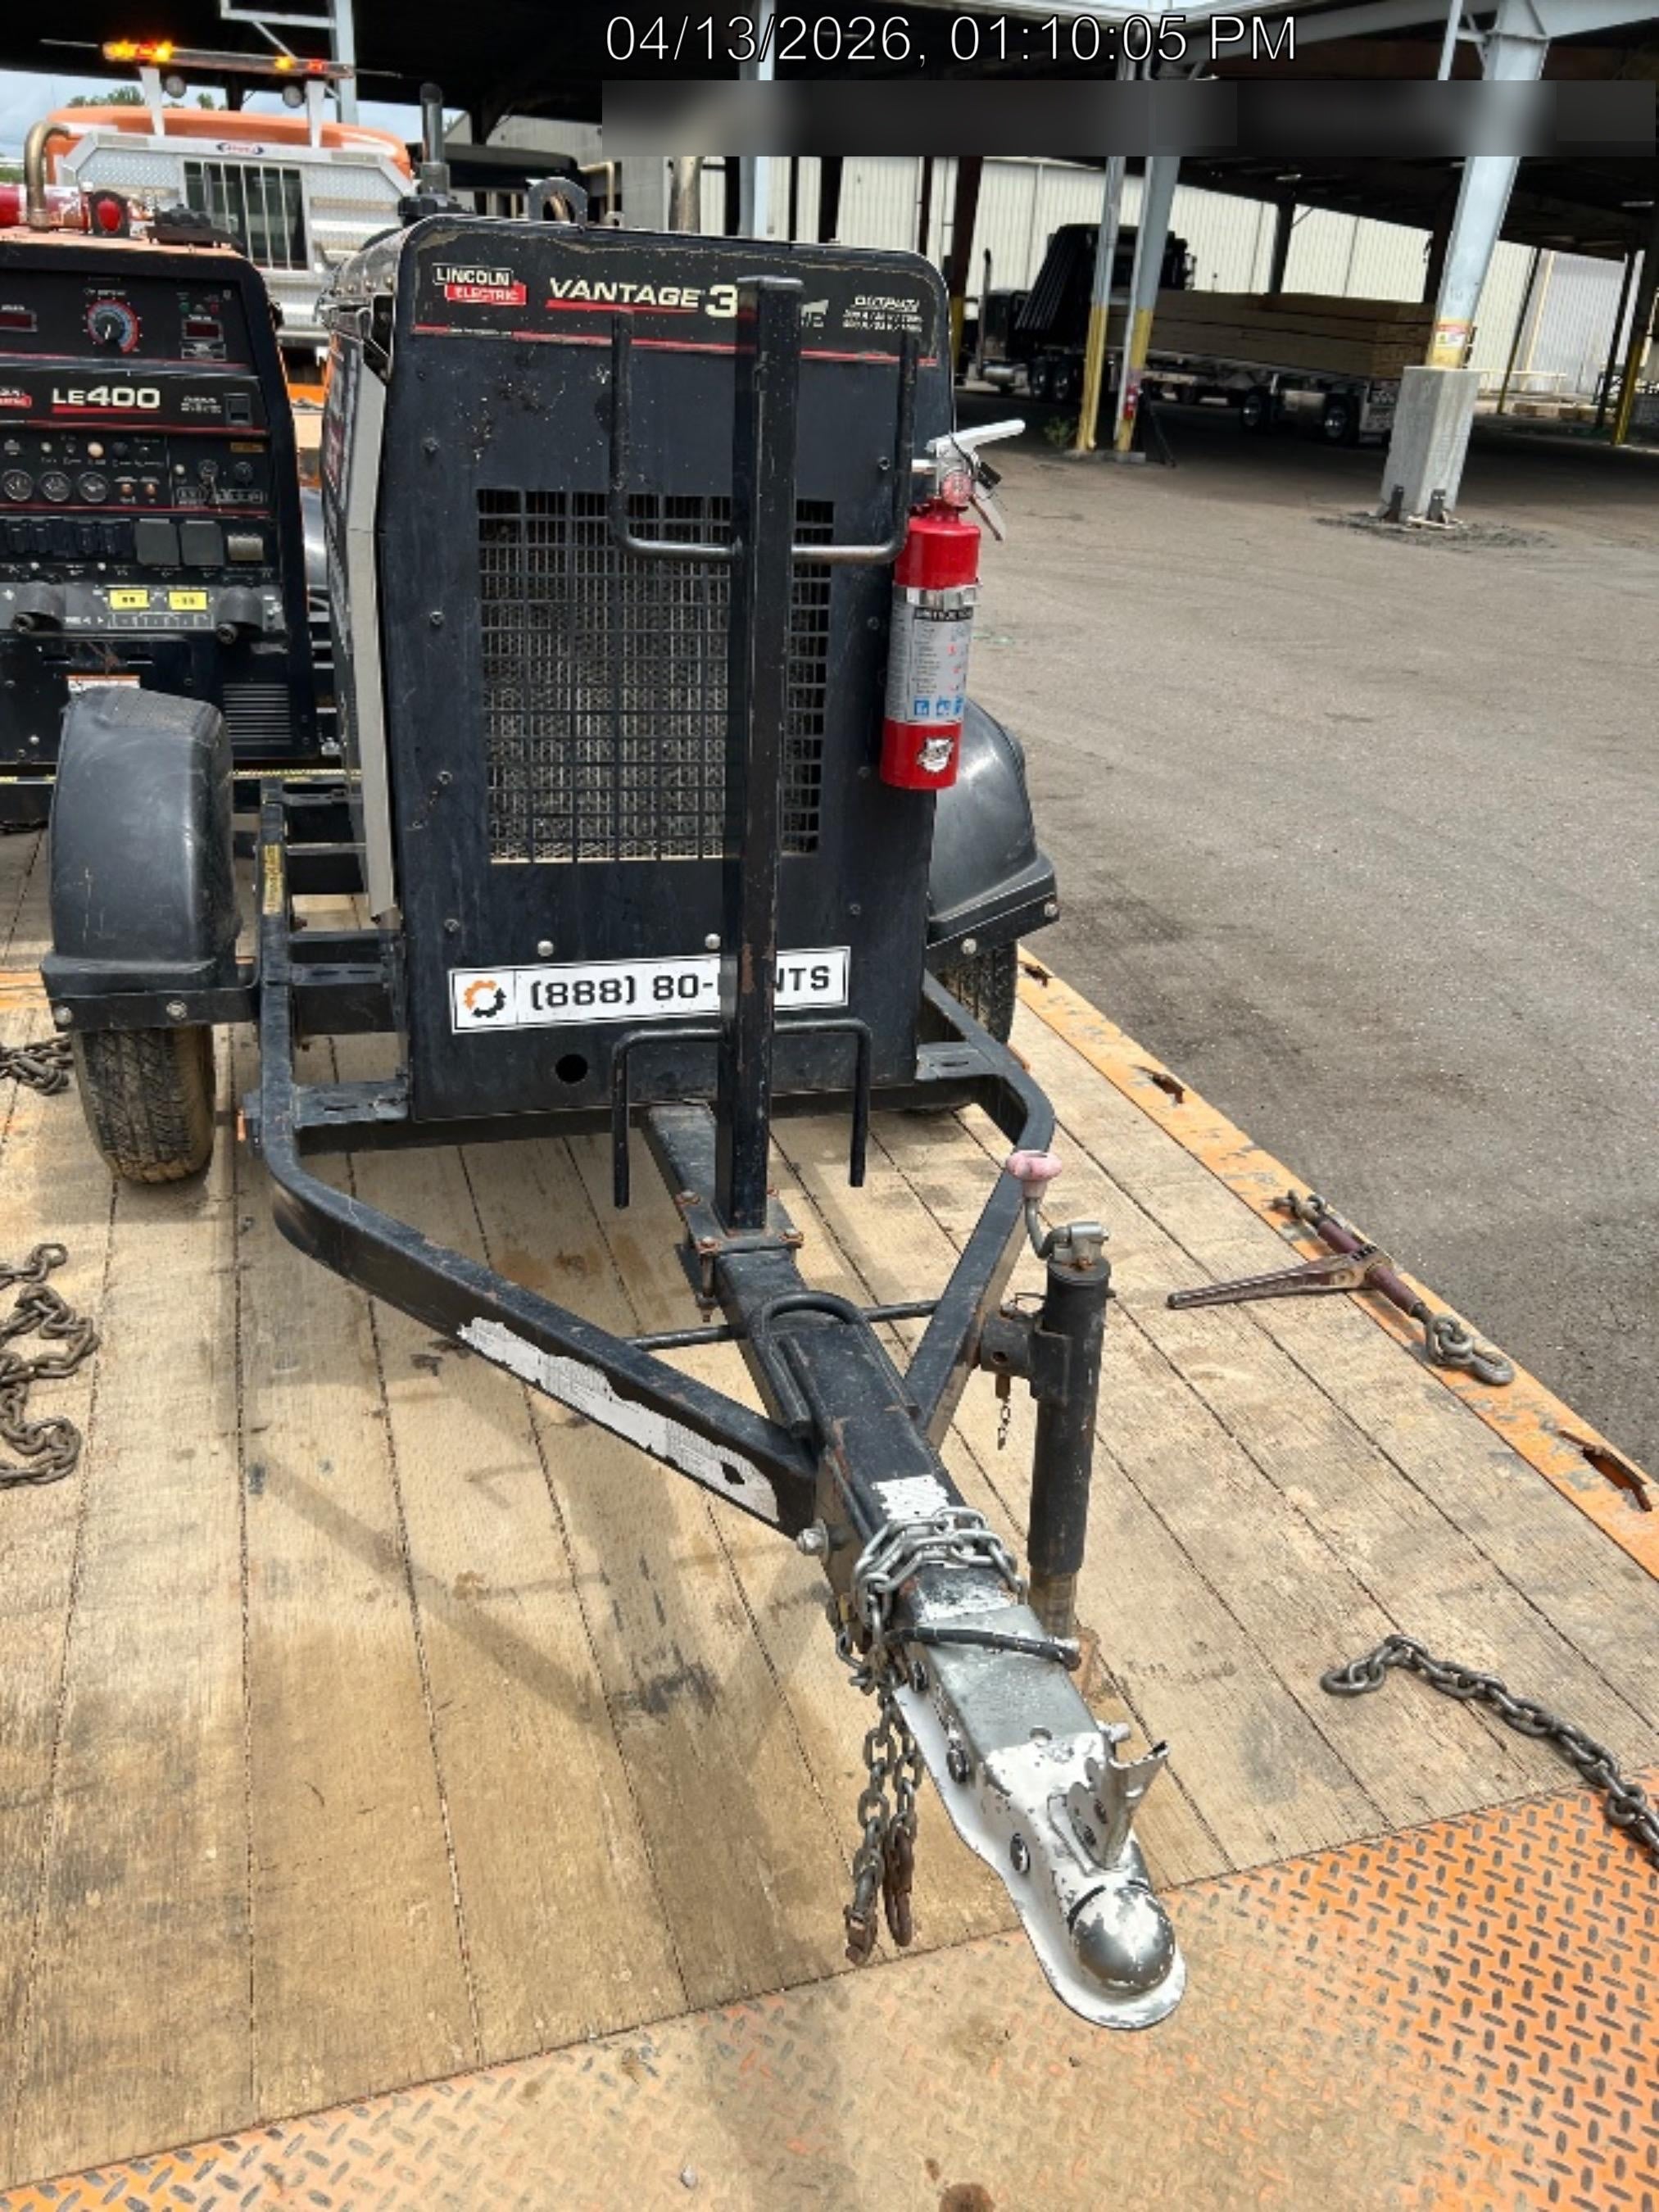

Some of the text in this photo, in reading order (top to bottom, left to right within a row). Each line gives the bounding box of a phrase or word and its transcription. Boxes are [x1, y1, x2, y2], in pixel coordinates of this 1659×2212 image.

[436, 266, 511, 286] LINCOLN
[454, 287, 520, 301] ELECTRIC
[549, 276, 702, 309] VANTAGE
[52, 385, 161, 409] LE400
[531, 974, 635, 1010] (888)
